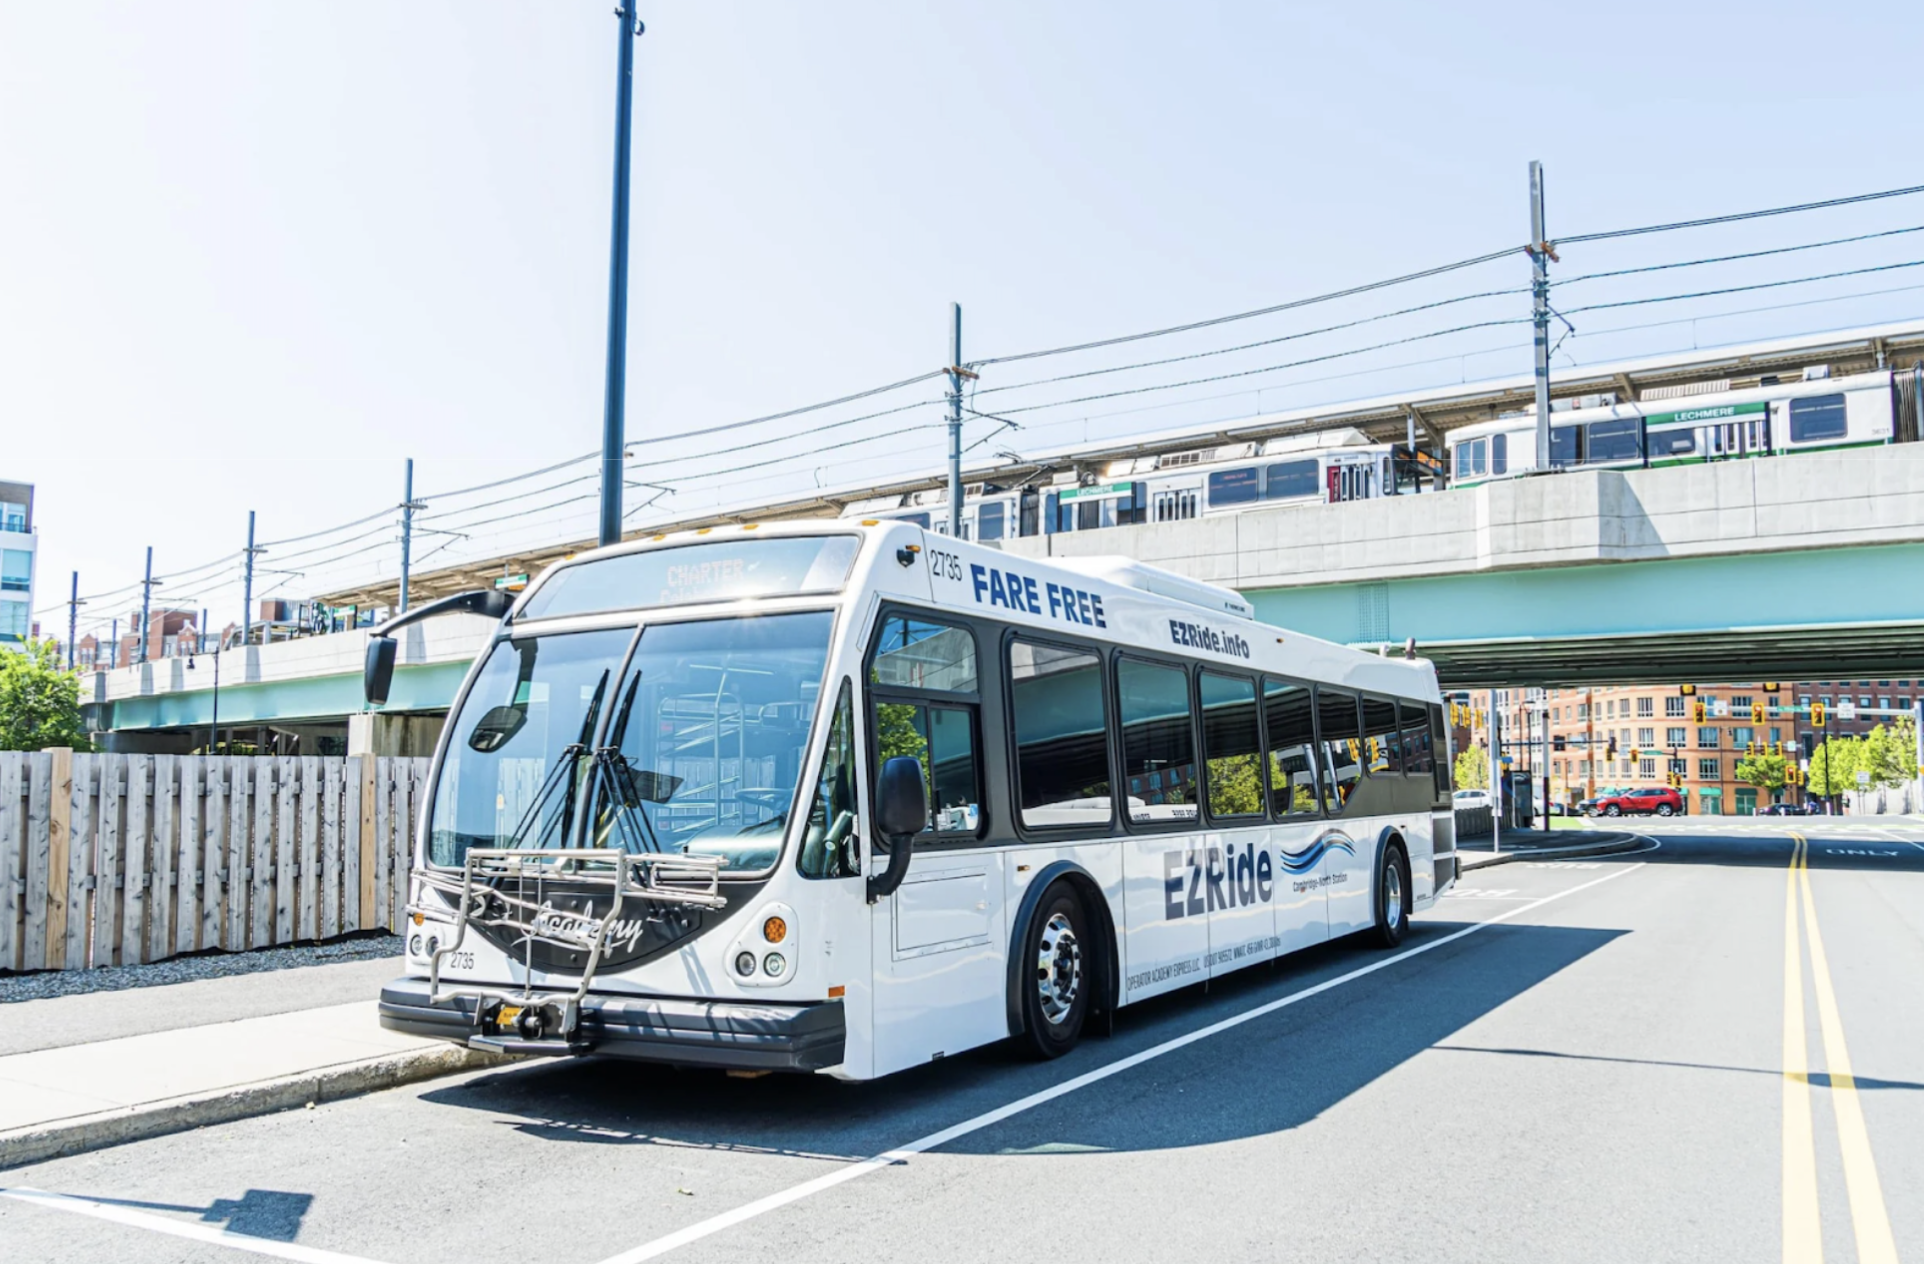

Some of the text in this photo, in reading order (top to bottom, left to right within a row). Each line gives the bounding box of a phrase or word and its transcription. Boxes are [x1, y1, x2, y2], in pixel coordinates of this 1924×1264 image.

[1674, 406, 1735, 422] LECHMERE
[1076, 484, 1114, 496] LECHMERE
[667, 558, 744, 588] CHARTER
[929, 550, 963, 582] 2735
[969, 563, 1107, 629] FARE FREE
[1168, 619, 1250, 660] EZRide.info
[1826, 848, 1898, 856] ONLY
[1163, 842, 1272, 921] EZRide
[450, 950, 475, 970] 2735
